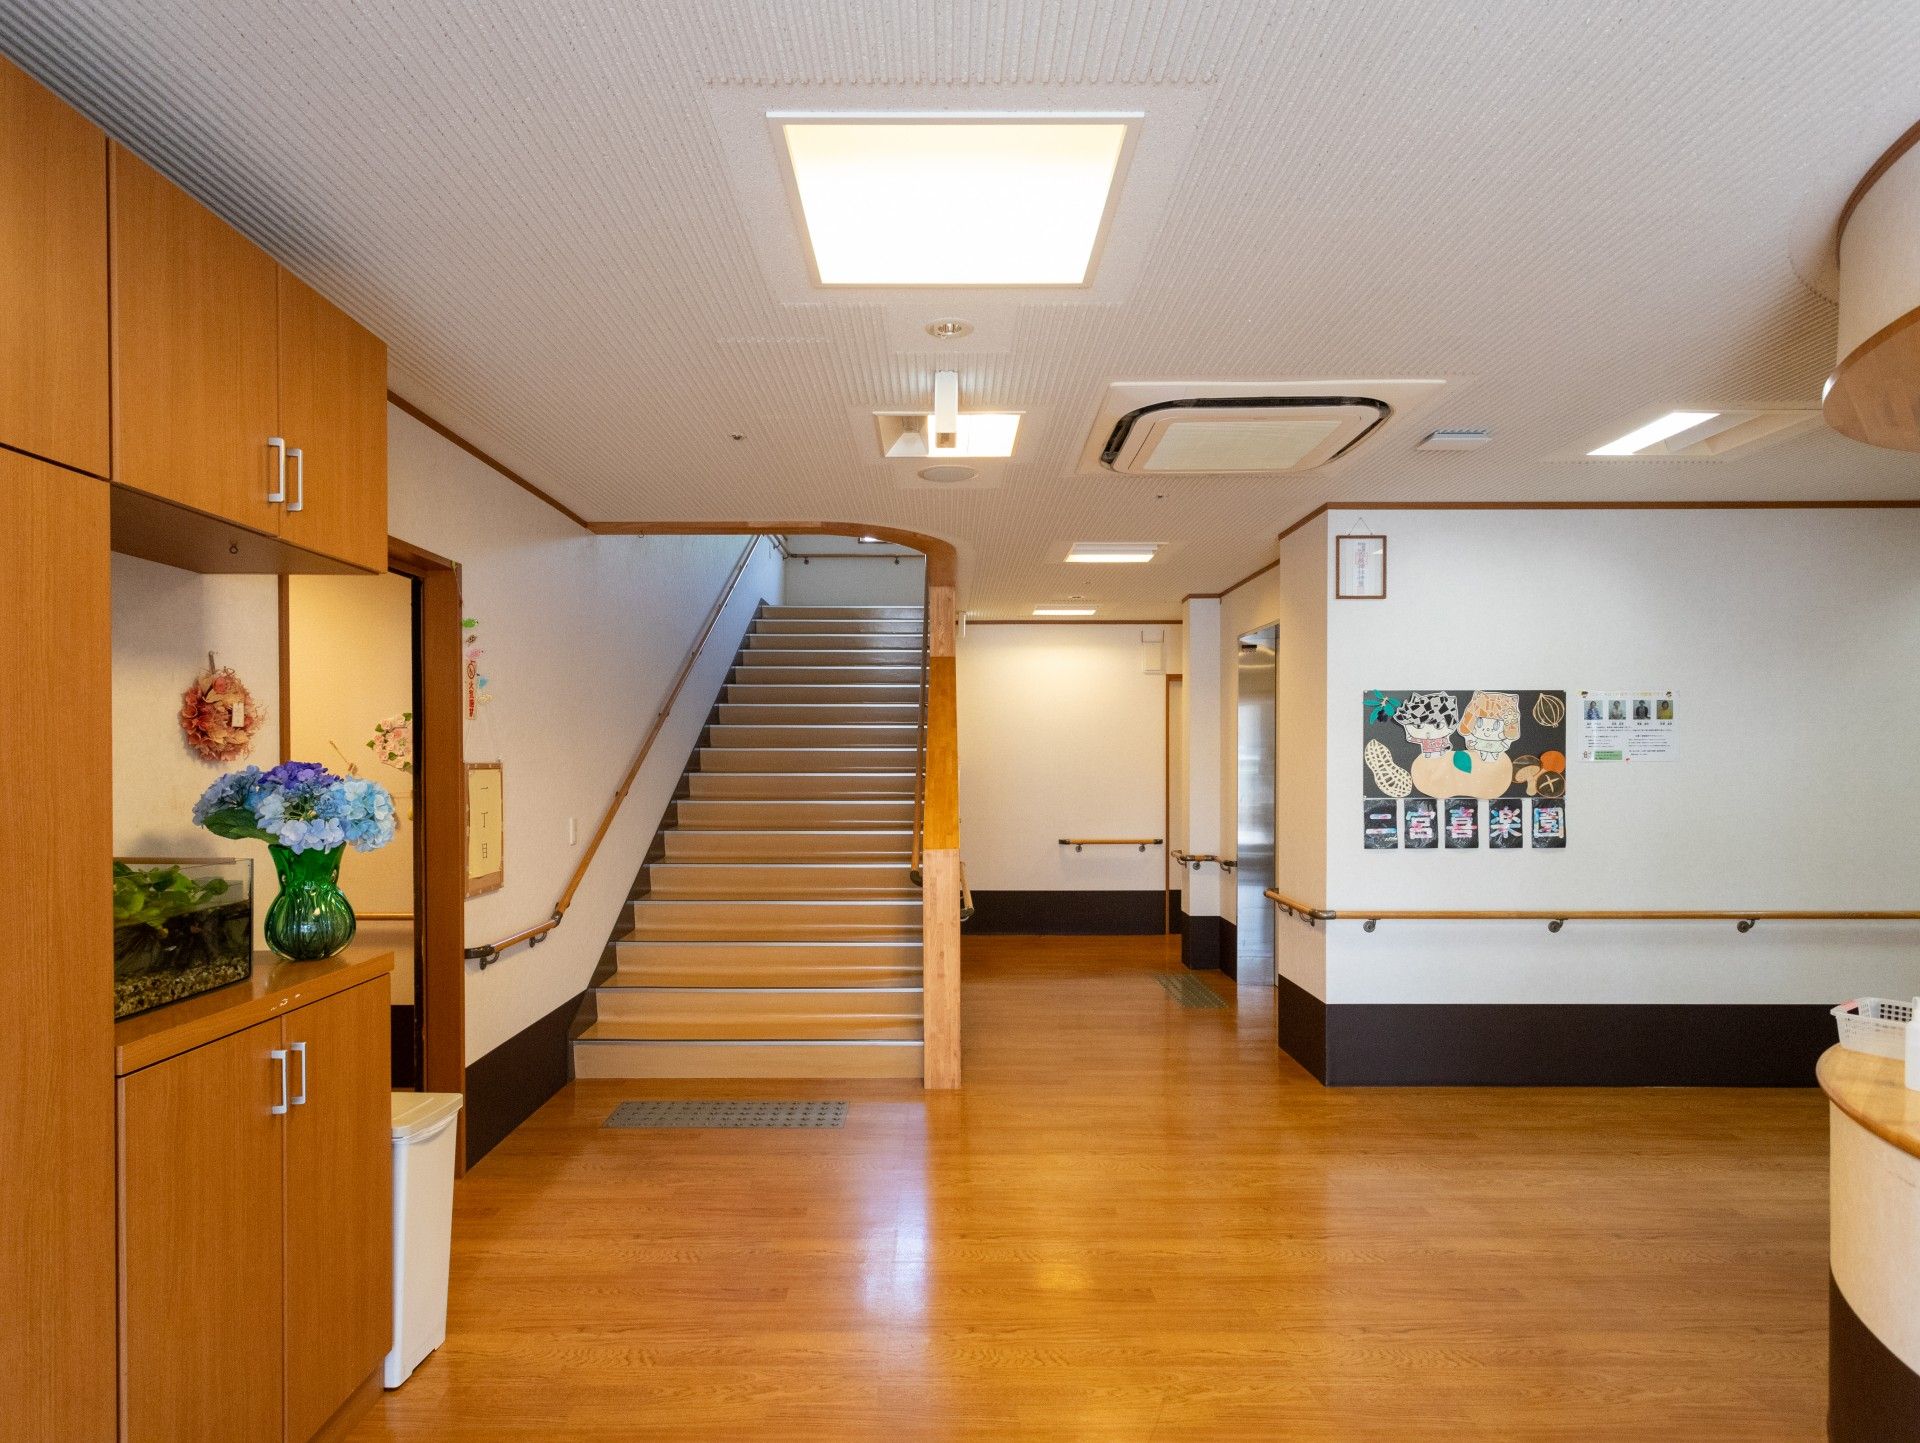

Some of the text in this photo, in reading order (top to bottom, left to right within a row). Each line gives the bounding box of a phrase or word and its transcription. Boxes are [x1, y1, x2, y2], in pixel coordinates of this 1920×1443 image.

[480, 786, 489, 859] 一丁目
[1365, 806, 1565, 839] 二宮喜楽園
